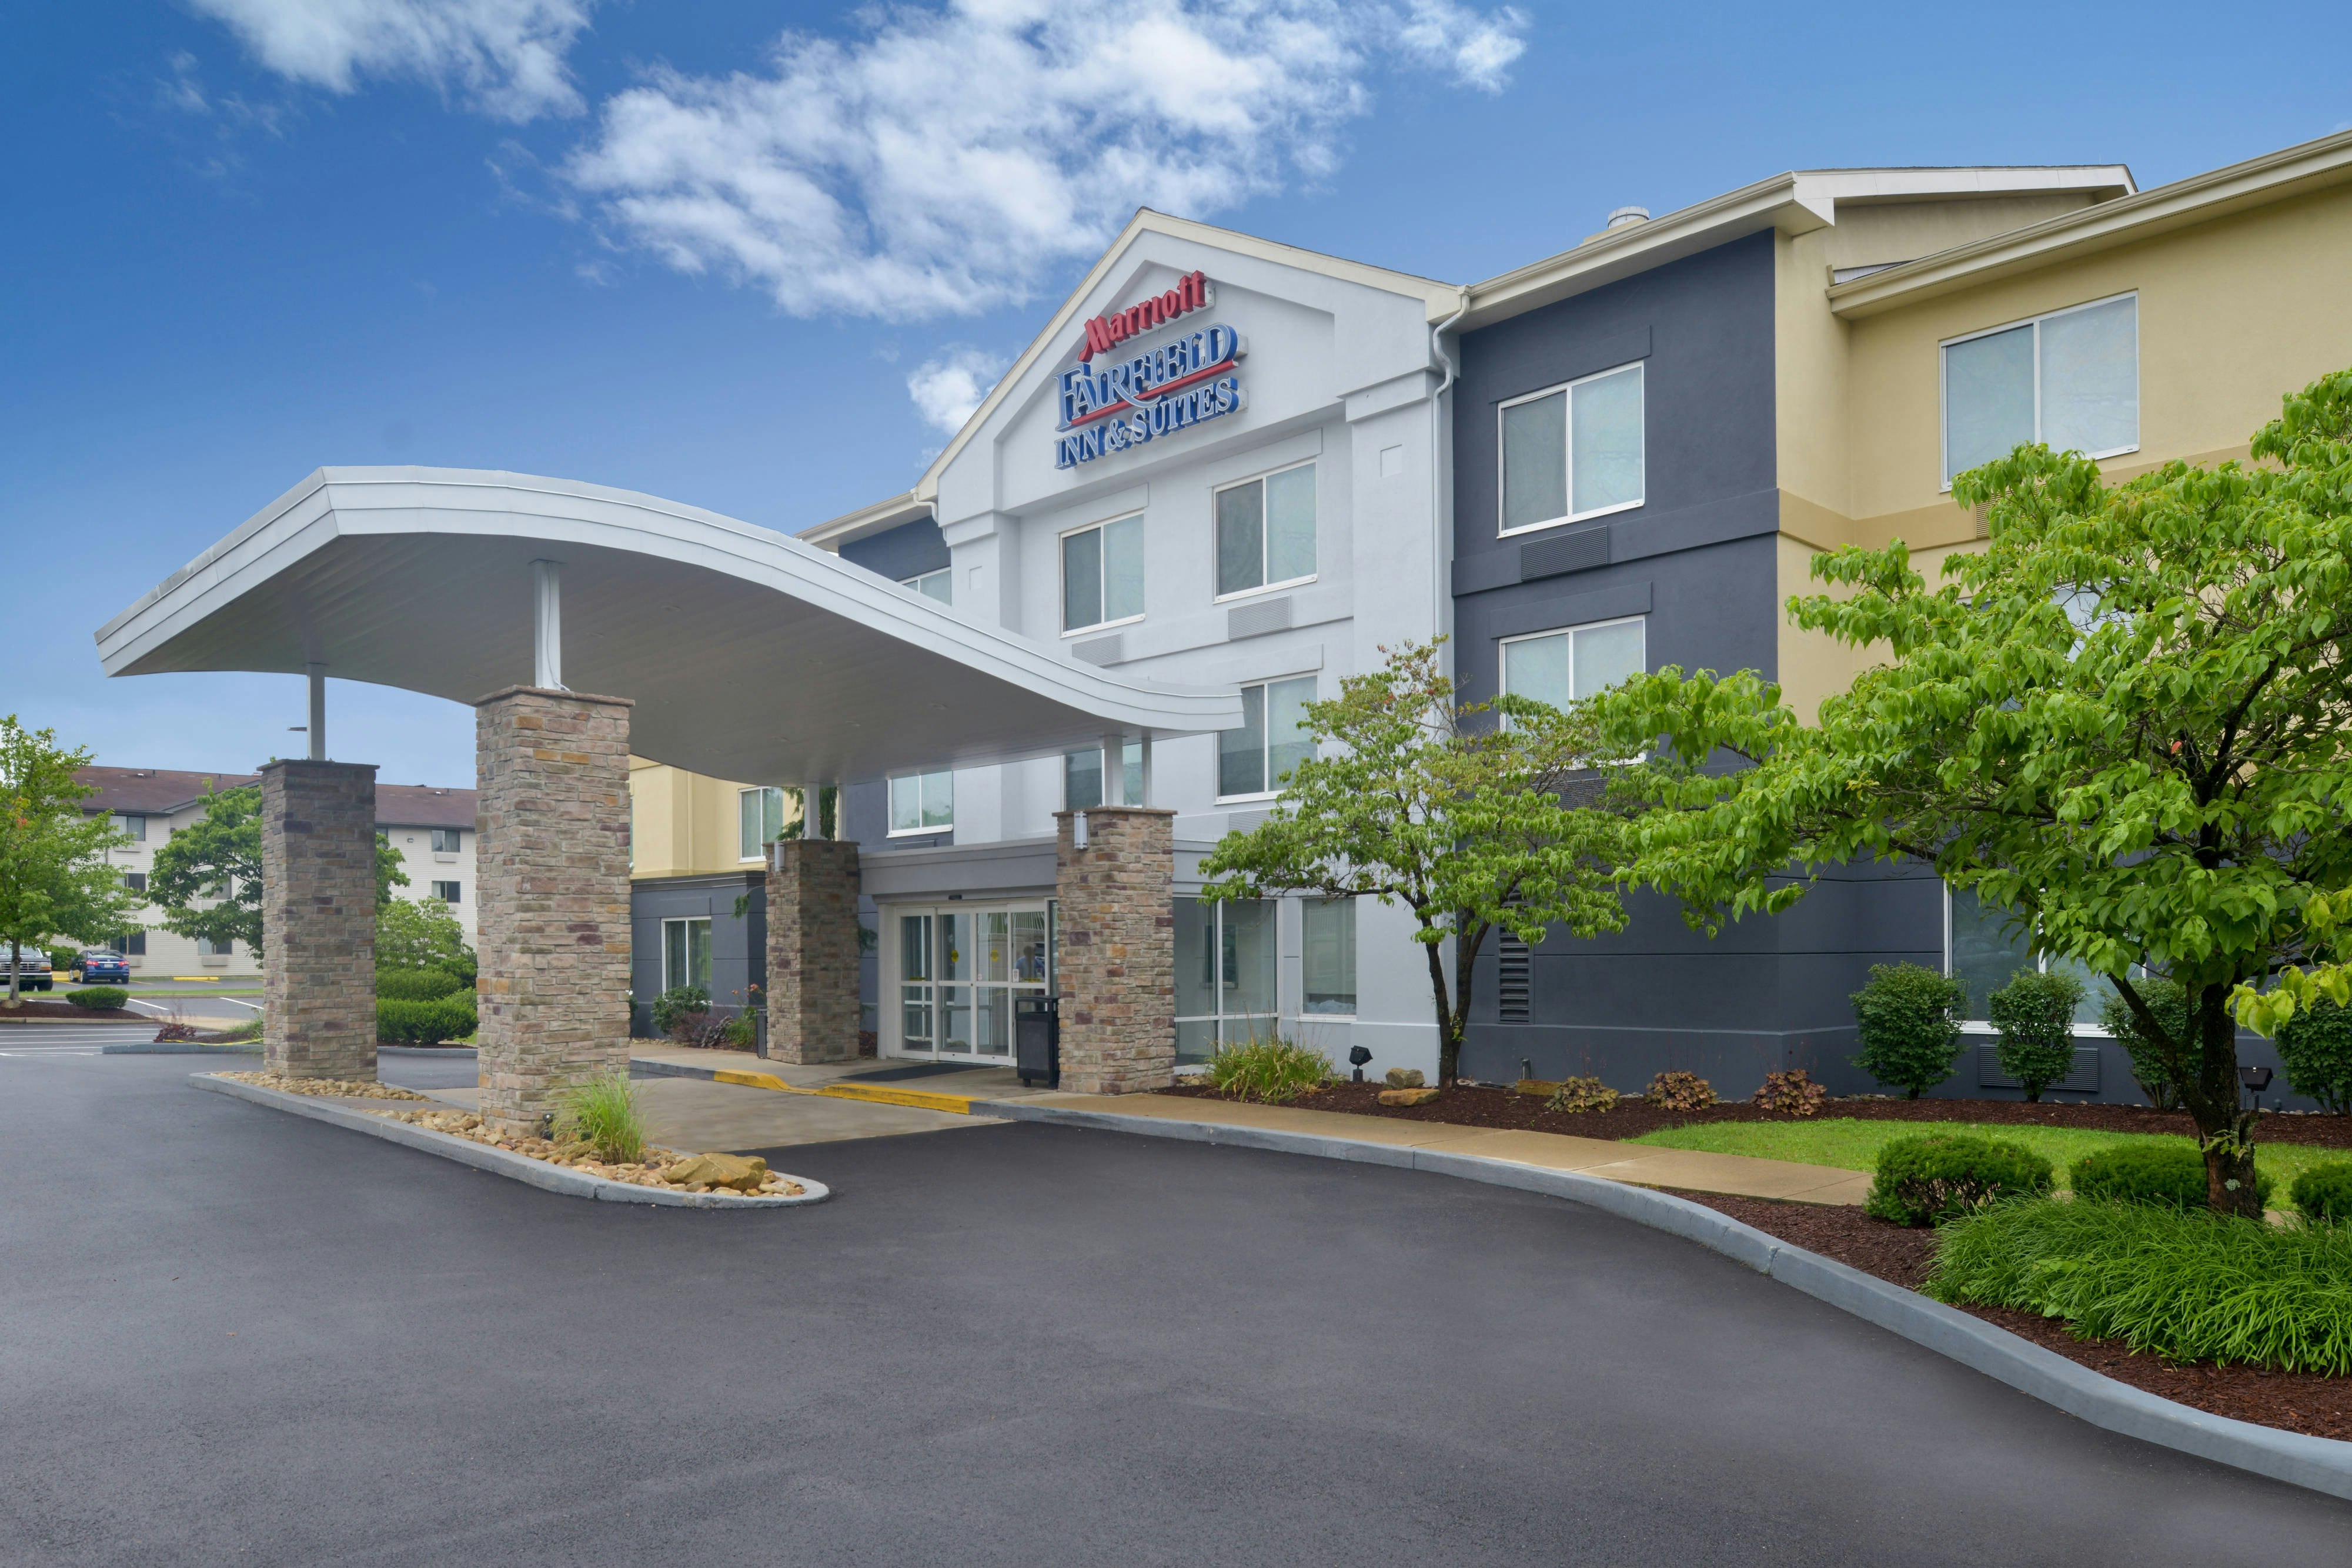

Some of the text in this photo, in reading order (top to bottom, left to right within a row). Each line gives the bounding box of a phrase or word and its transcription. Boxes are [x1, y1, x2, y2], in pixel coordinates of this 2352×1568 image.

[1077, 270, 1207, 363] Marriott
[1053, 323, 1238, 432] FAIRFIELD
[1054, 377, 1239, 470] INN & SUITES
